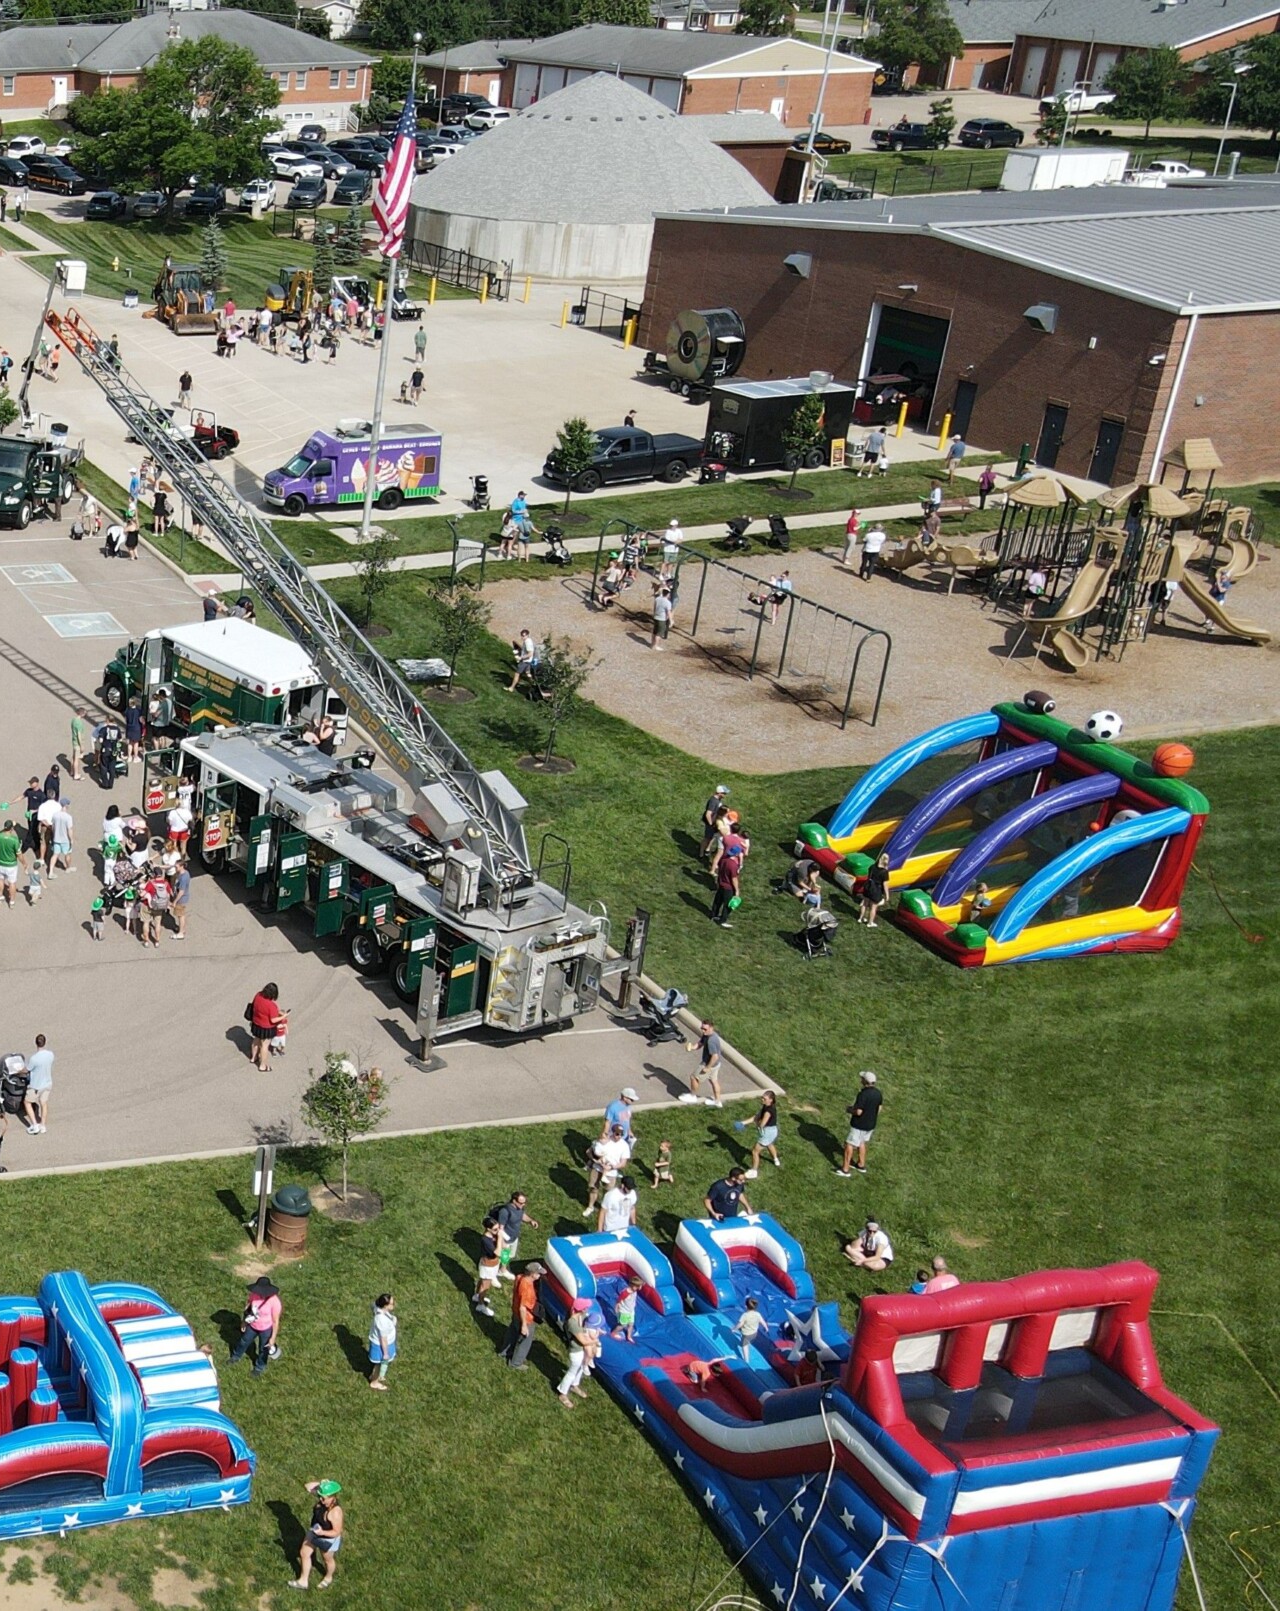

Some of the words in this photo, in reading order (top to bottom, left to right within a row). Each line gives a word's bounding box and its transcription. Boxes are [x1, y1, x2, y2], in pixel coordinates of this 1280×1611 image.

[358, 708, 380, 735] 92
[379, 733, 410, 772] DER
[147, 797, 164, 806] STOP
